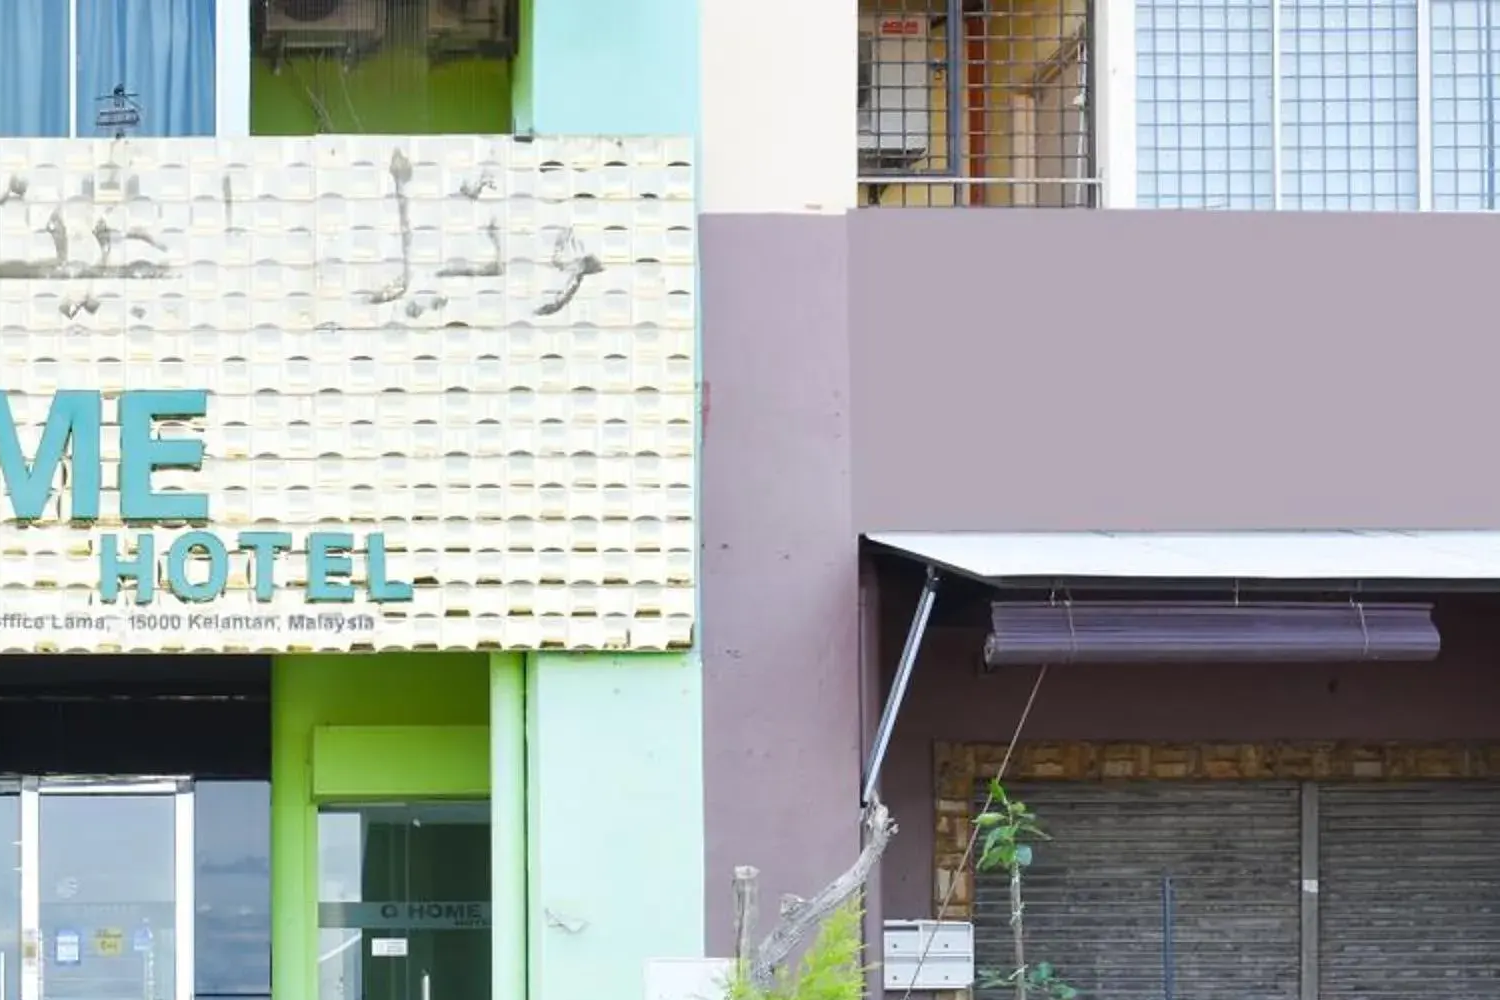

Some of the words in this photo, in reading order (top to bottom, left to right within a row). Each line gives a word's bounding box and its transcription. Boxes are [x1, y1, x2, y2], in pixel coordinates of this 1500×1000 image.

[99, 530, 414, 605] HOTEL
[52, 613, 111, 632] Lama,
[128, 613, 181, 631] 15000
[188, 613, 282, 632] Kelantan,
[288, 612, 375, 632] Malaysia
